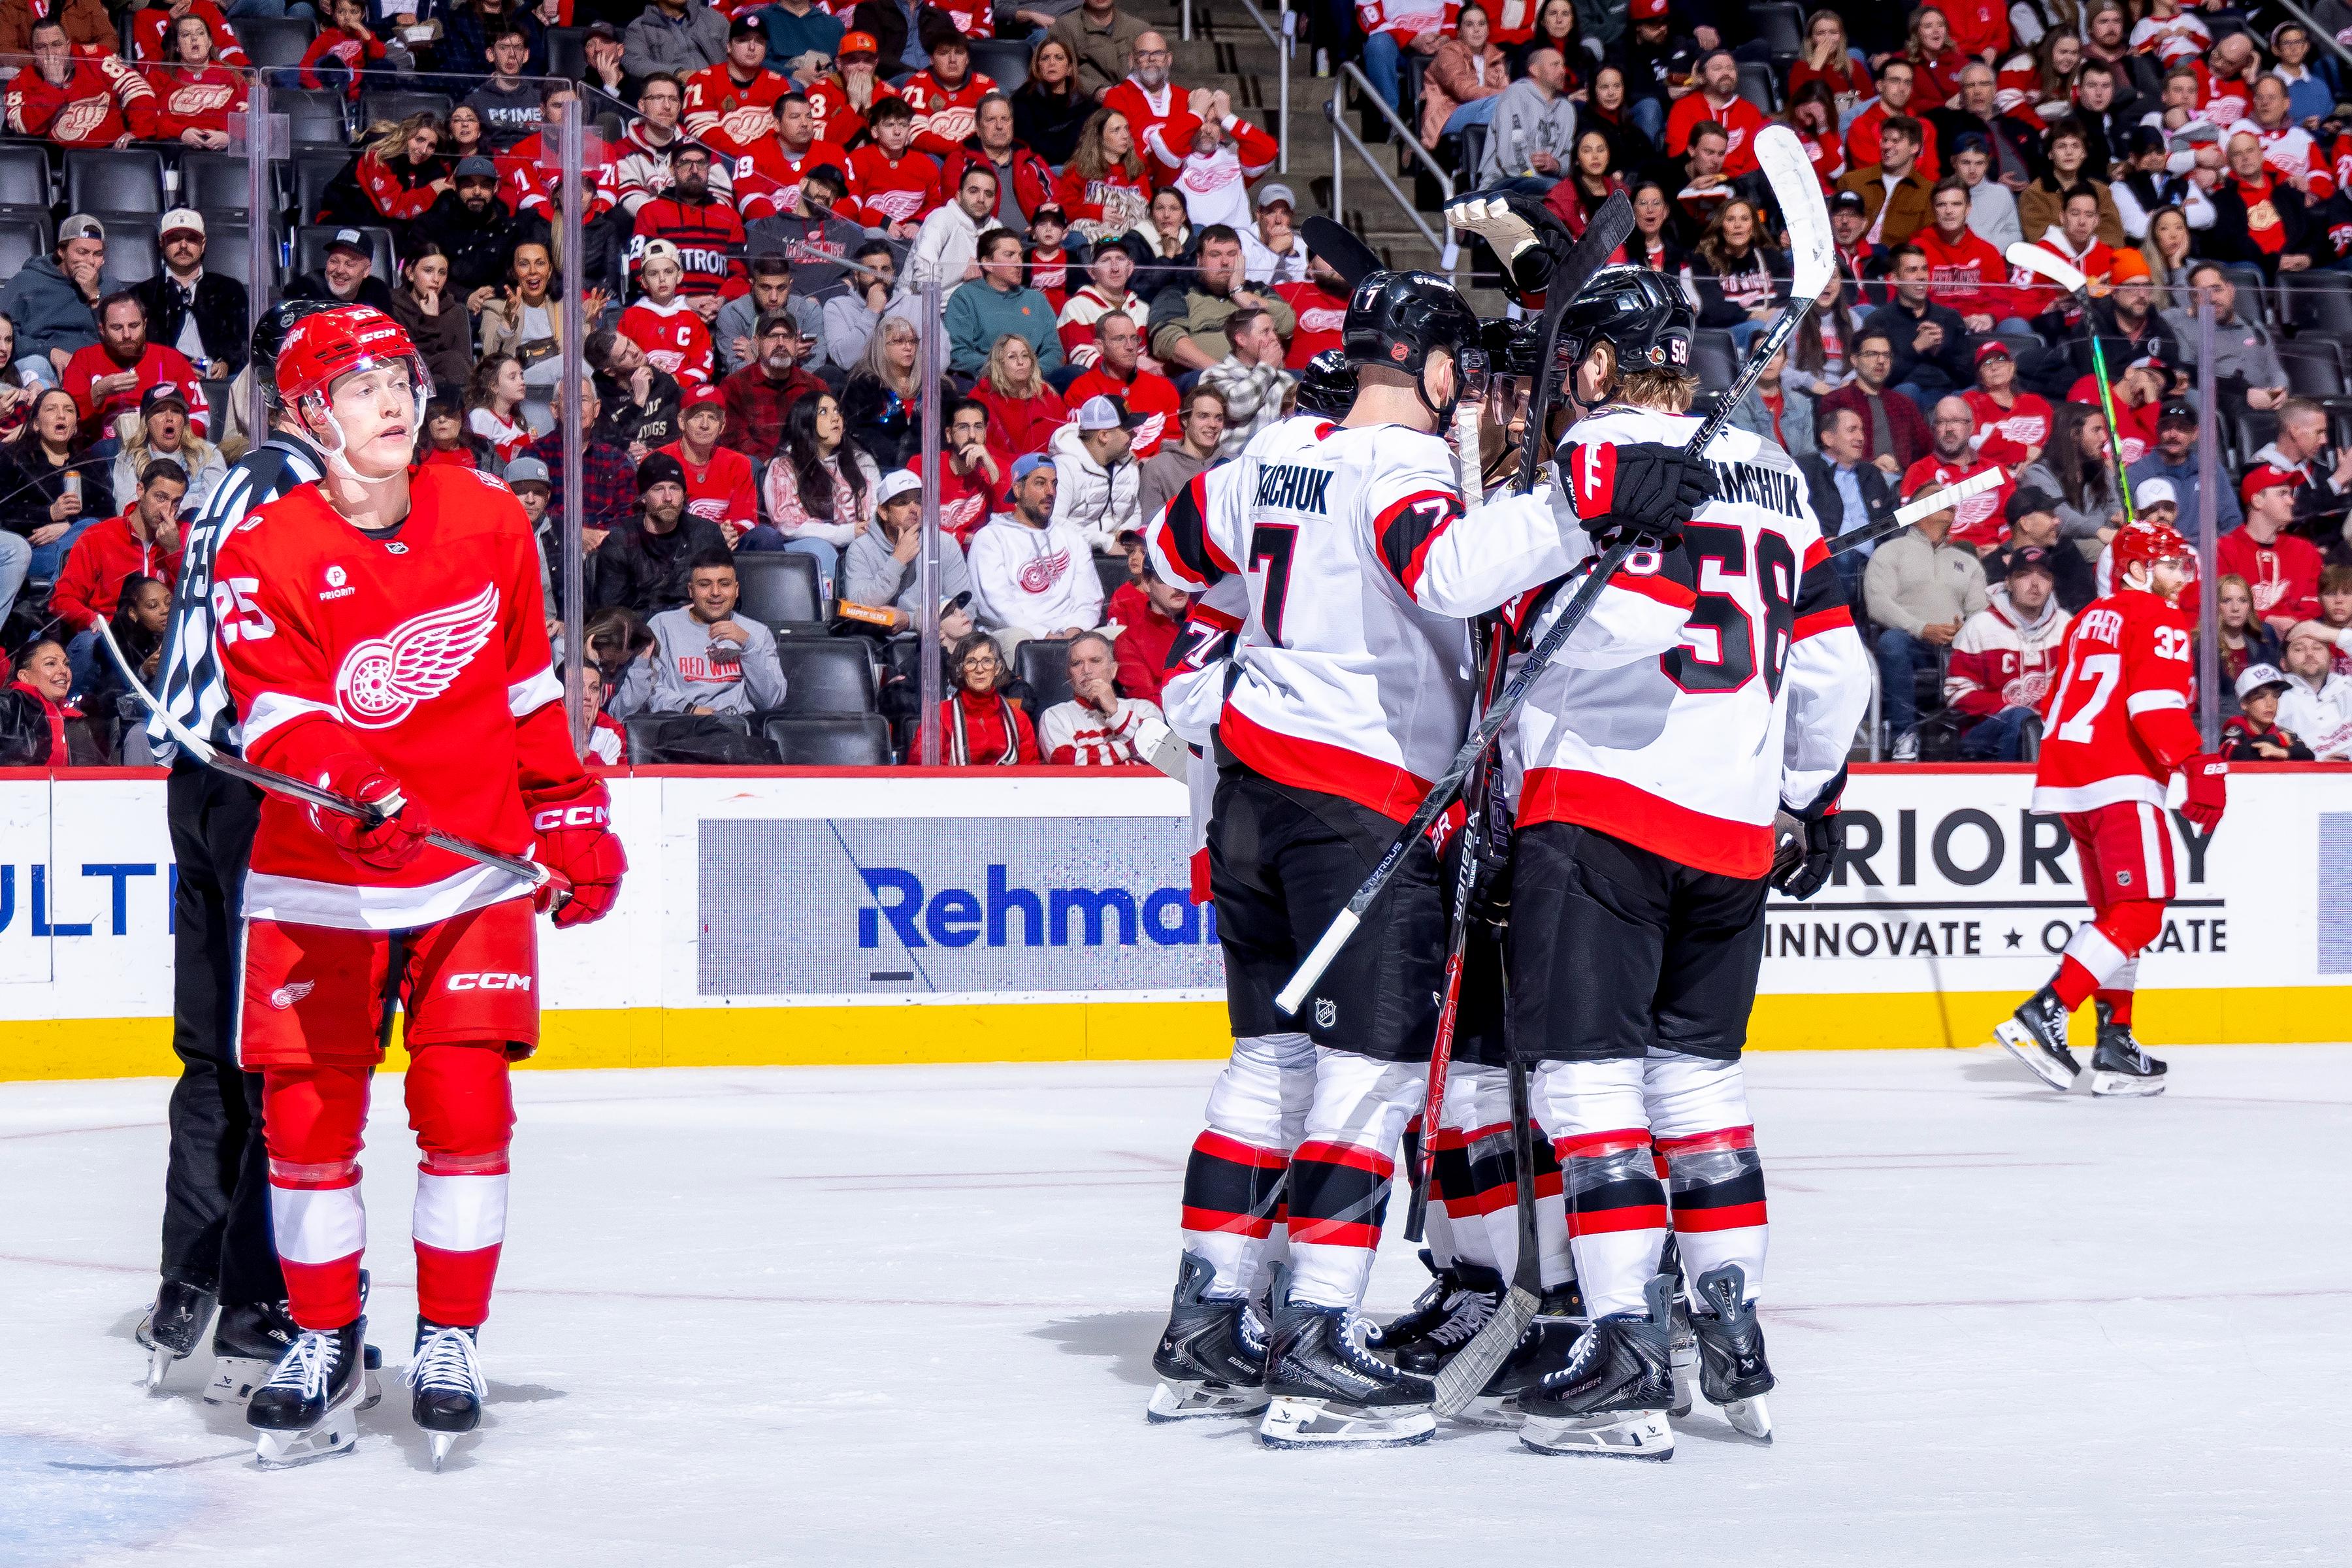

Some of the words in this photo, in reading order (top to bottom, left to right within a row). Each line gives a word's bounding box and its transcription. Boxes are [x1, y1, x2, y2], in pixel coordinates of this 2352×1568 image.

[901, 85, 926, 110] 71
[359, 329, 397, 344] CCM
[677, 327, 691, 346] C
[1671, 339, 1687, 364] 58
[1409, 497, 1450, 530] 7
[319, 586, 355, 602] PRIORITY
[1247, 523, 1299, 650] 7
[212, 578, 276, 649] 25
[1659, 521, 1795, 704] 58
[2153, 625, 2191, 663] 37
[679, 657, 704, 676] RED
[708, 656, 743, 677] WIN
[2001, 653, 2016, 674] C
[2044, 653, 2122, 743] 7
[534, 806, 611, 831] CCM
[1832, 808, 2213, 887] RIORY
[1367, 841, 1403, 887] HZRDUS
[0, 864, 175, 936] LT
[858, 864, 1220, 948] Rehma
[1765, 921, 1981, 958] INNOVATE
[446, 972, 532, 992] CCM
[1319, 1007, 1333, 1020] NHL
[1227, 1356, 1256, 1375] BAUER
[1331, 1363, 1380, 1389] BAUER
[1561, 1376, 1602, 1400] BAUER
